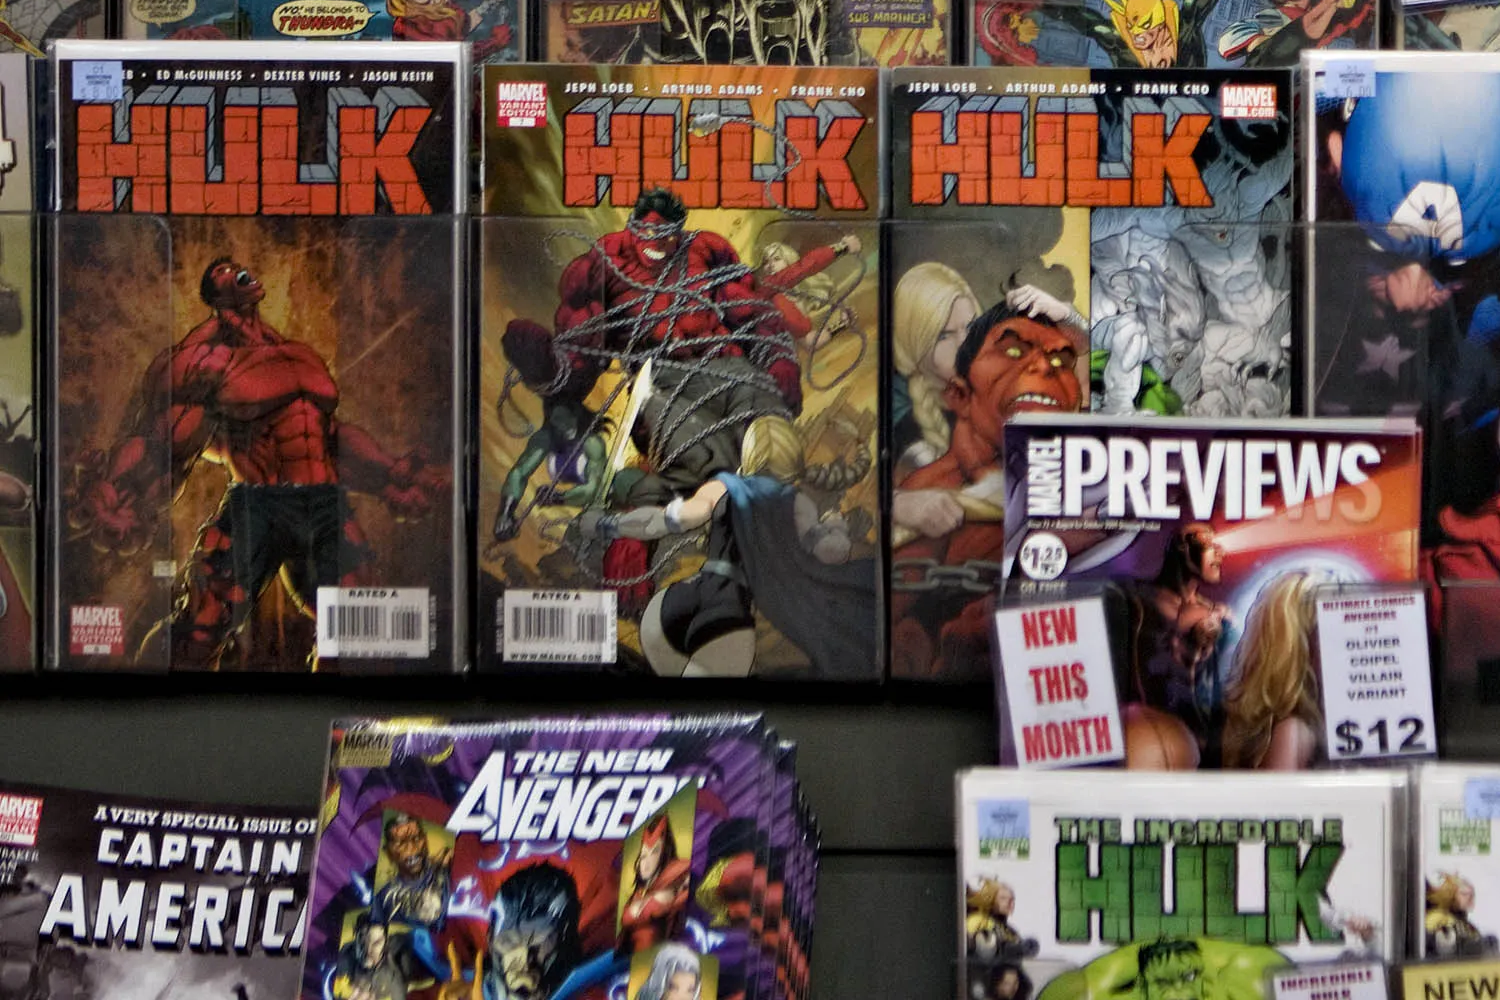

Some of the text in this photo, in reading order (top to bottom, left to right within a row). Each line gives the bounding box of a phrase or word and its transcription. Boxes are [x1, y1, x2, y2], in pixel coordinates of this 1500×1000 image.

[264, 70, 433, 81] DEXTER VINES JASON KEITH
[1134, 84, 1210, 95] FRANK CHO
[77, 87, 433, 216] HULK
[564, 97, 868, 210] HULK
[912, 95, 1214, 207] HULK
[1064, 437, 1382, 522] PREVIEWS
[1021, 606, 1077, 649] NEW
[1029, 662, 1088, 705] THIS
[1023, 716, 1112, 762] MONTH
[1335, 717, 1427, 756] $12
[513, 749, 674, 773] THE NEW
[110, 808, 292, 834] VERY SPECIAL ISSUE
[1054, 817, 1343, 844] THE INCREDIBLE
[97, 828, 302, 876] CAPTAIN
[1055, 843, 1345, 944] HULK
[1424, 977, 1499, 1000] NEW
